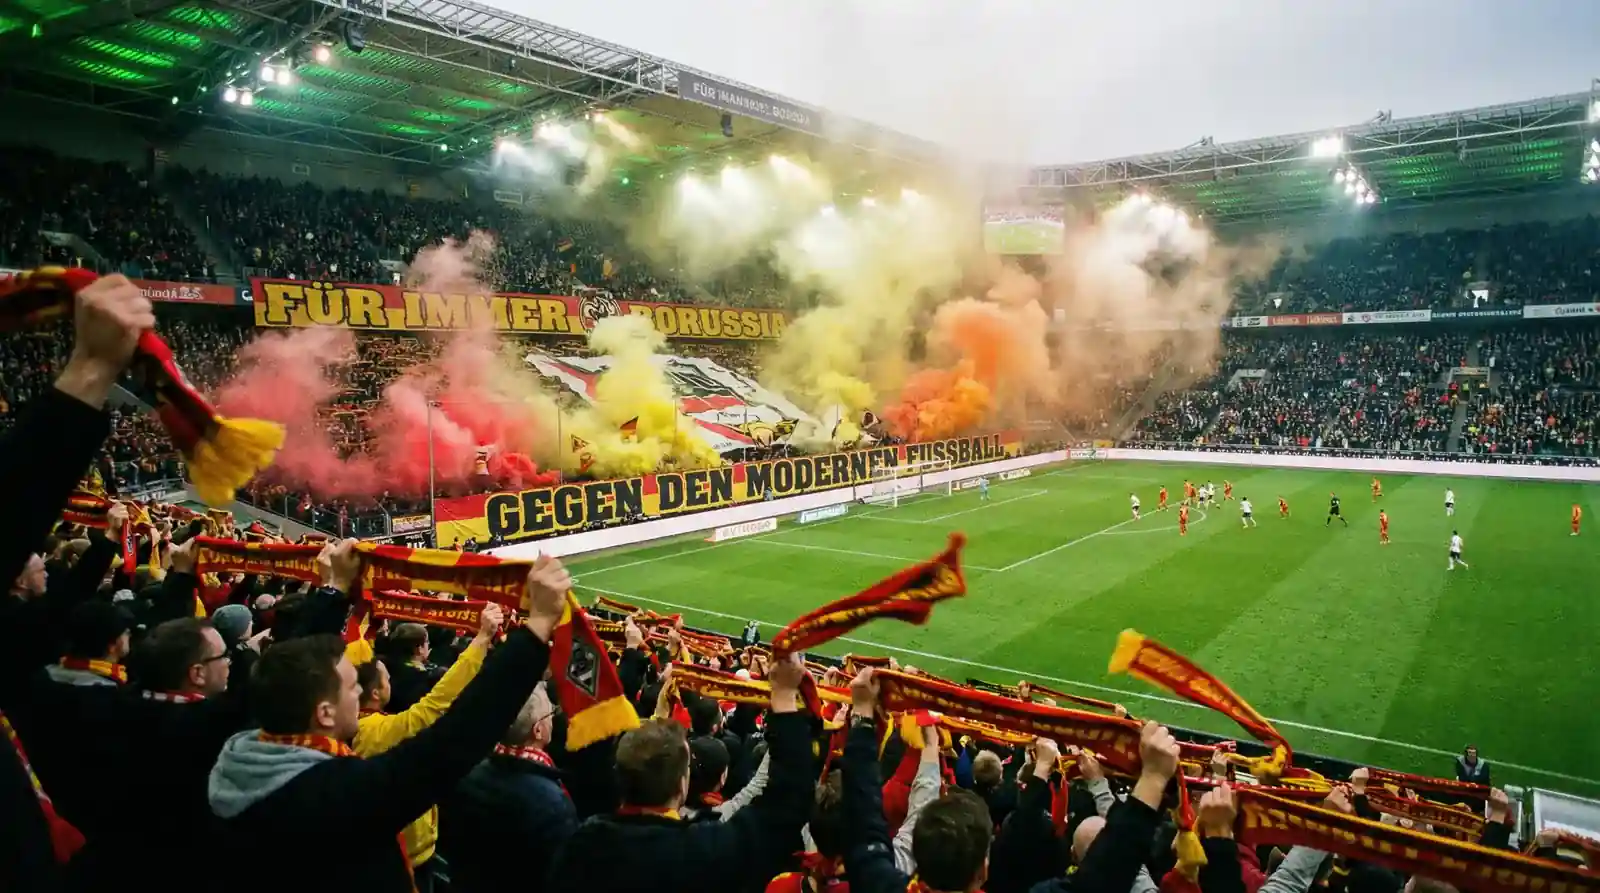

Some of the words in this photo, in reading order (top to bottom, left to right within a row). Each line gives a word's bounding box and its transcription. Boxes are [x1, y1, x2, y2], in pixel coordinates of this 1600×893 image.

[693, 82, 715, 100] FÜR
[264, 281, 389, 328] FÜR
[401, 292, 570, 332] IMMER
[487, 478, 643, 537] GEGEN
[657, 468, 733, 511] DEN
[746, 447, 898, 497] MODERNEN
[906, 433, 1004, 472] FUSSBALL
